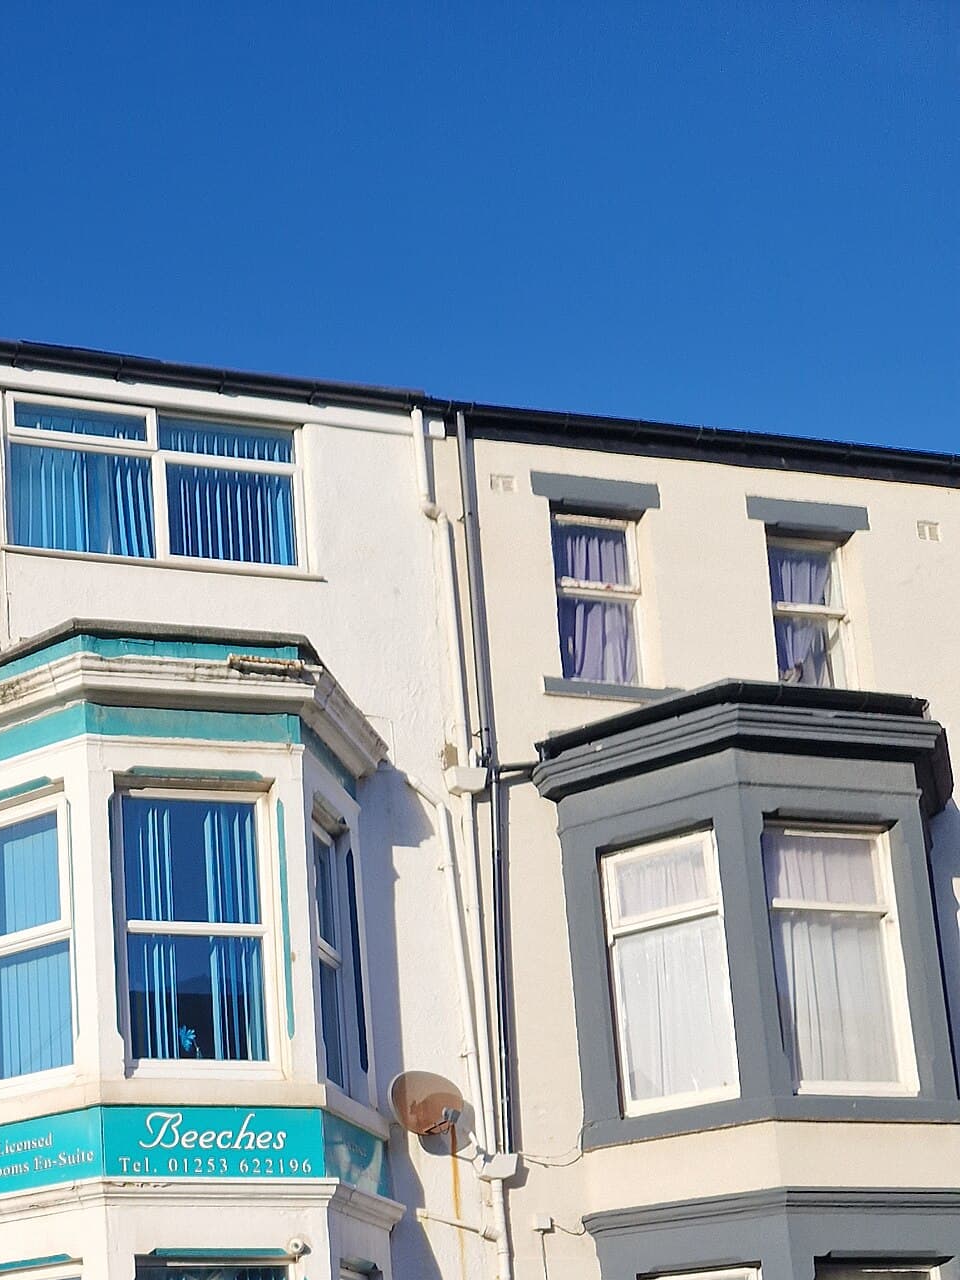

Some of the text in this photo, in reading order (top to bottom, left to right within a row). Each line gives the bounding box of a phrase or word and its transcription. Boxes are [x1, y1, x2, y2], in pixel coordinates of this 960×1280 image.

[139, 1111, 287, 1150] Beeches
[33, 1148, 95, 1170] En-Suite
[118, 1157, 312, 1174] Tel. 01253 622196
